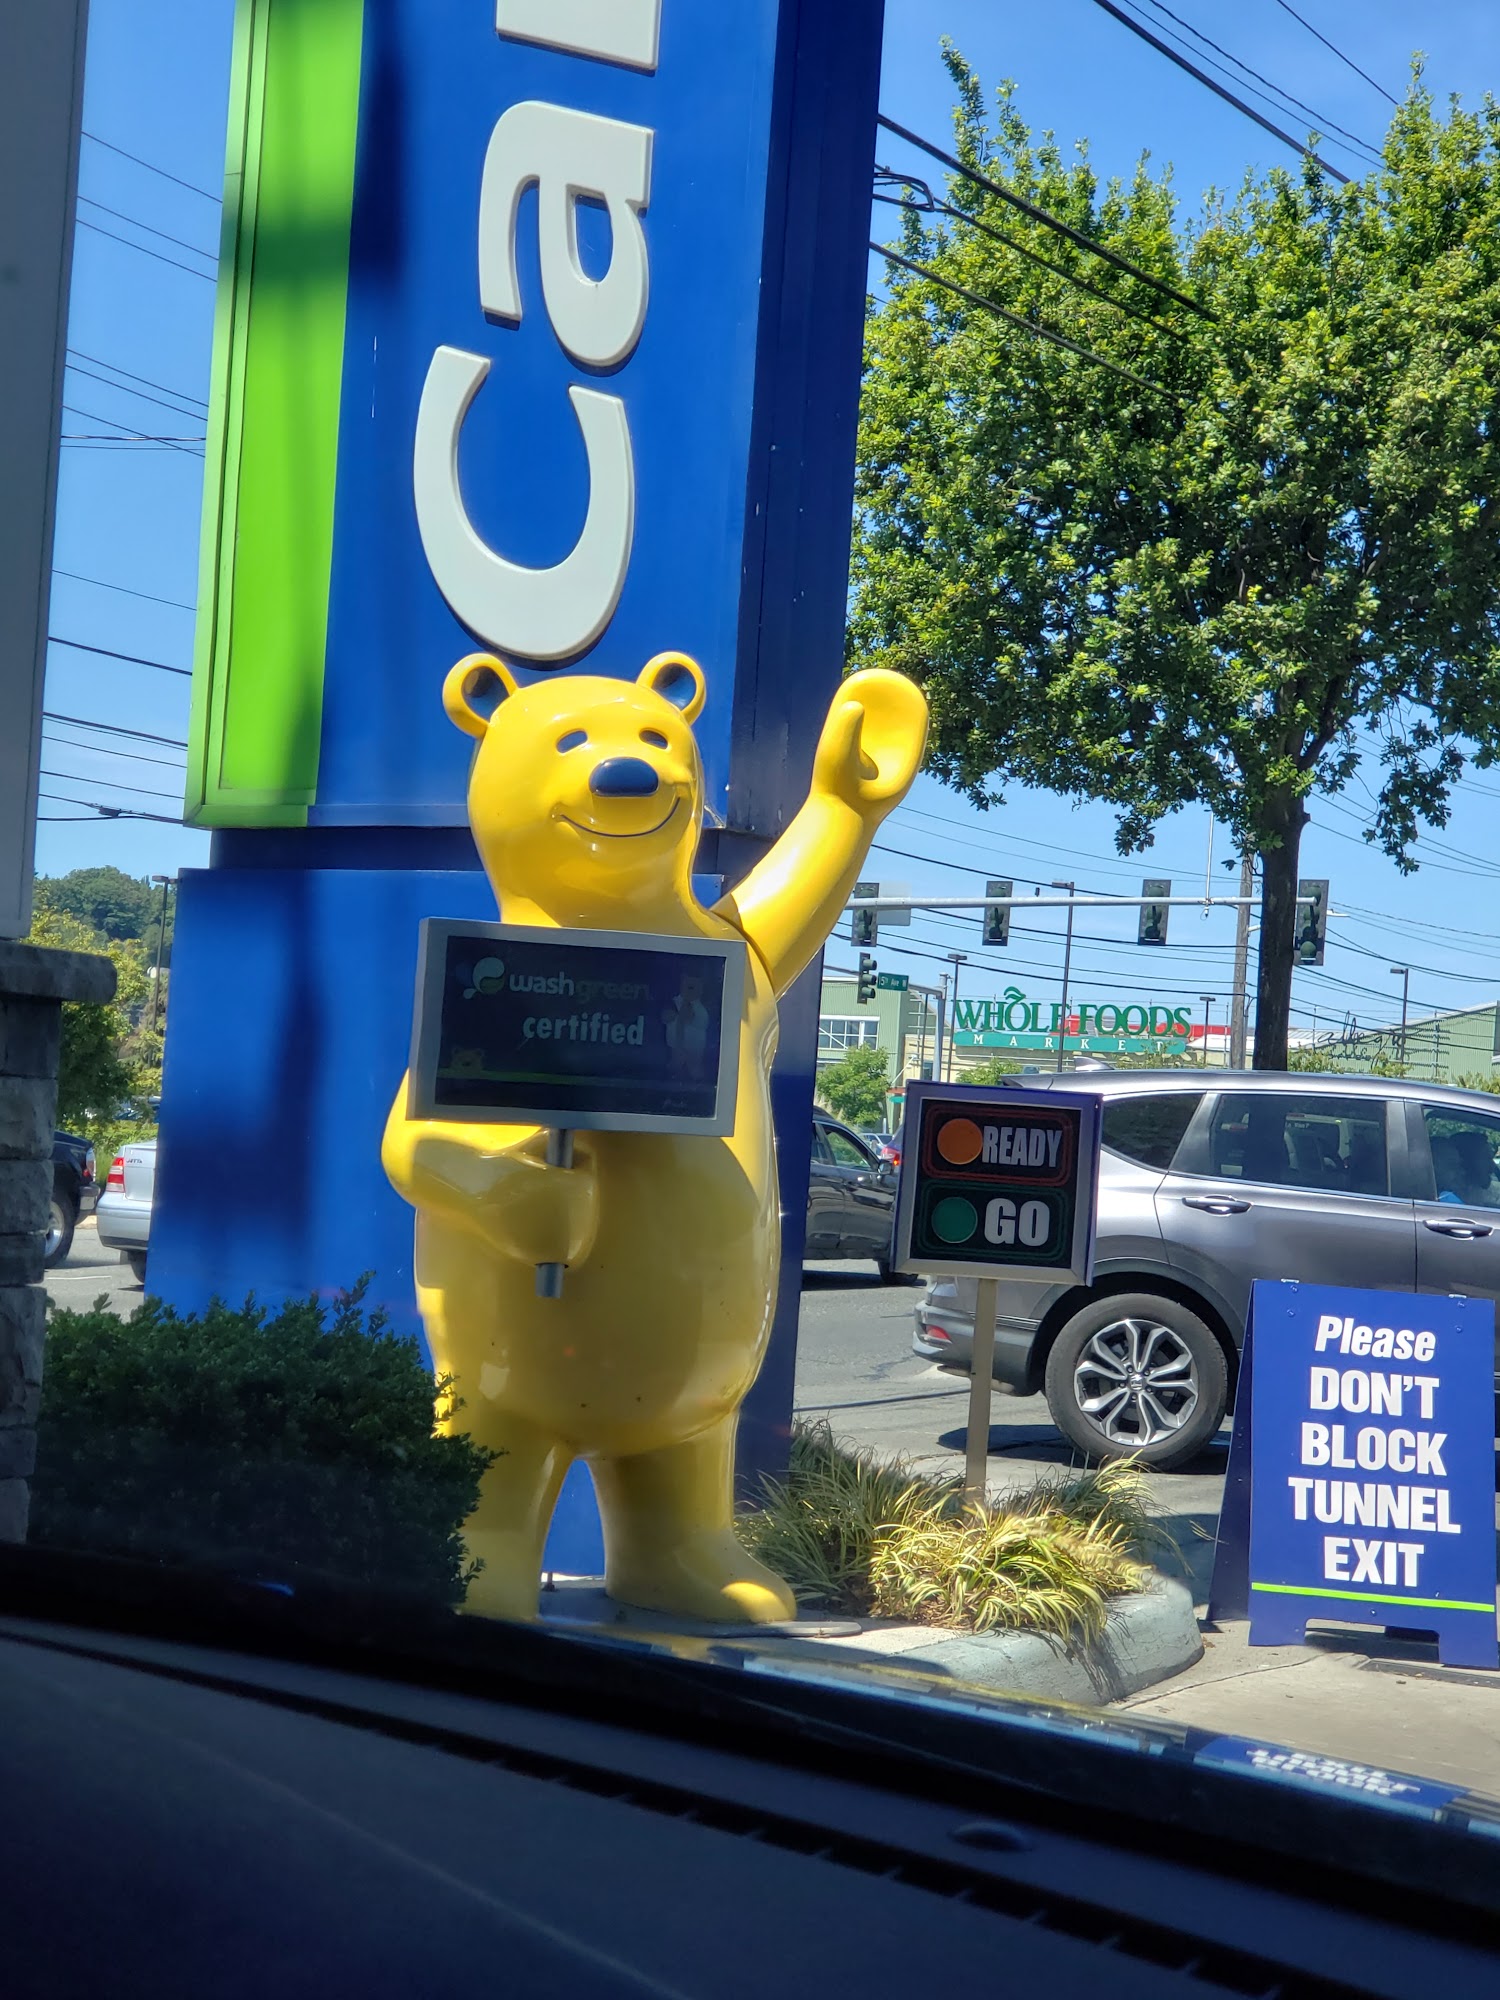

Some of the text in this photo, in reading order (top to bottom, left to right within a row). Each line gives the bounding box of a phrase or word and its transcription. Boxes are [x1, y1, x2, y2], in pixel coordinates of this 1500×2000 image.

[522, 1012, 646, 1047] certified
[951, 997, 1192, 1038] WHOLE FOODS
[981, 1125, 1063, 1168] READY
[984, 1197, 1050, 1247] GO
[1314, 1315, 1436, 1362] Please
[1301, 1421, 1448, 1477] BLOCK
[1287, 1476, 1462, 1534] TUNNEL
[1323, 1536, 1425, 1588] EXIT
